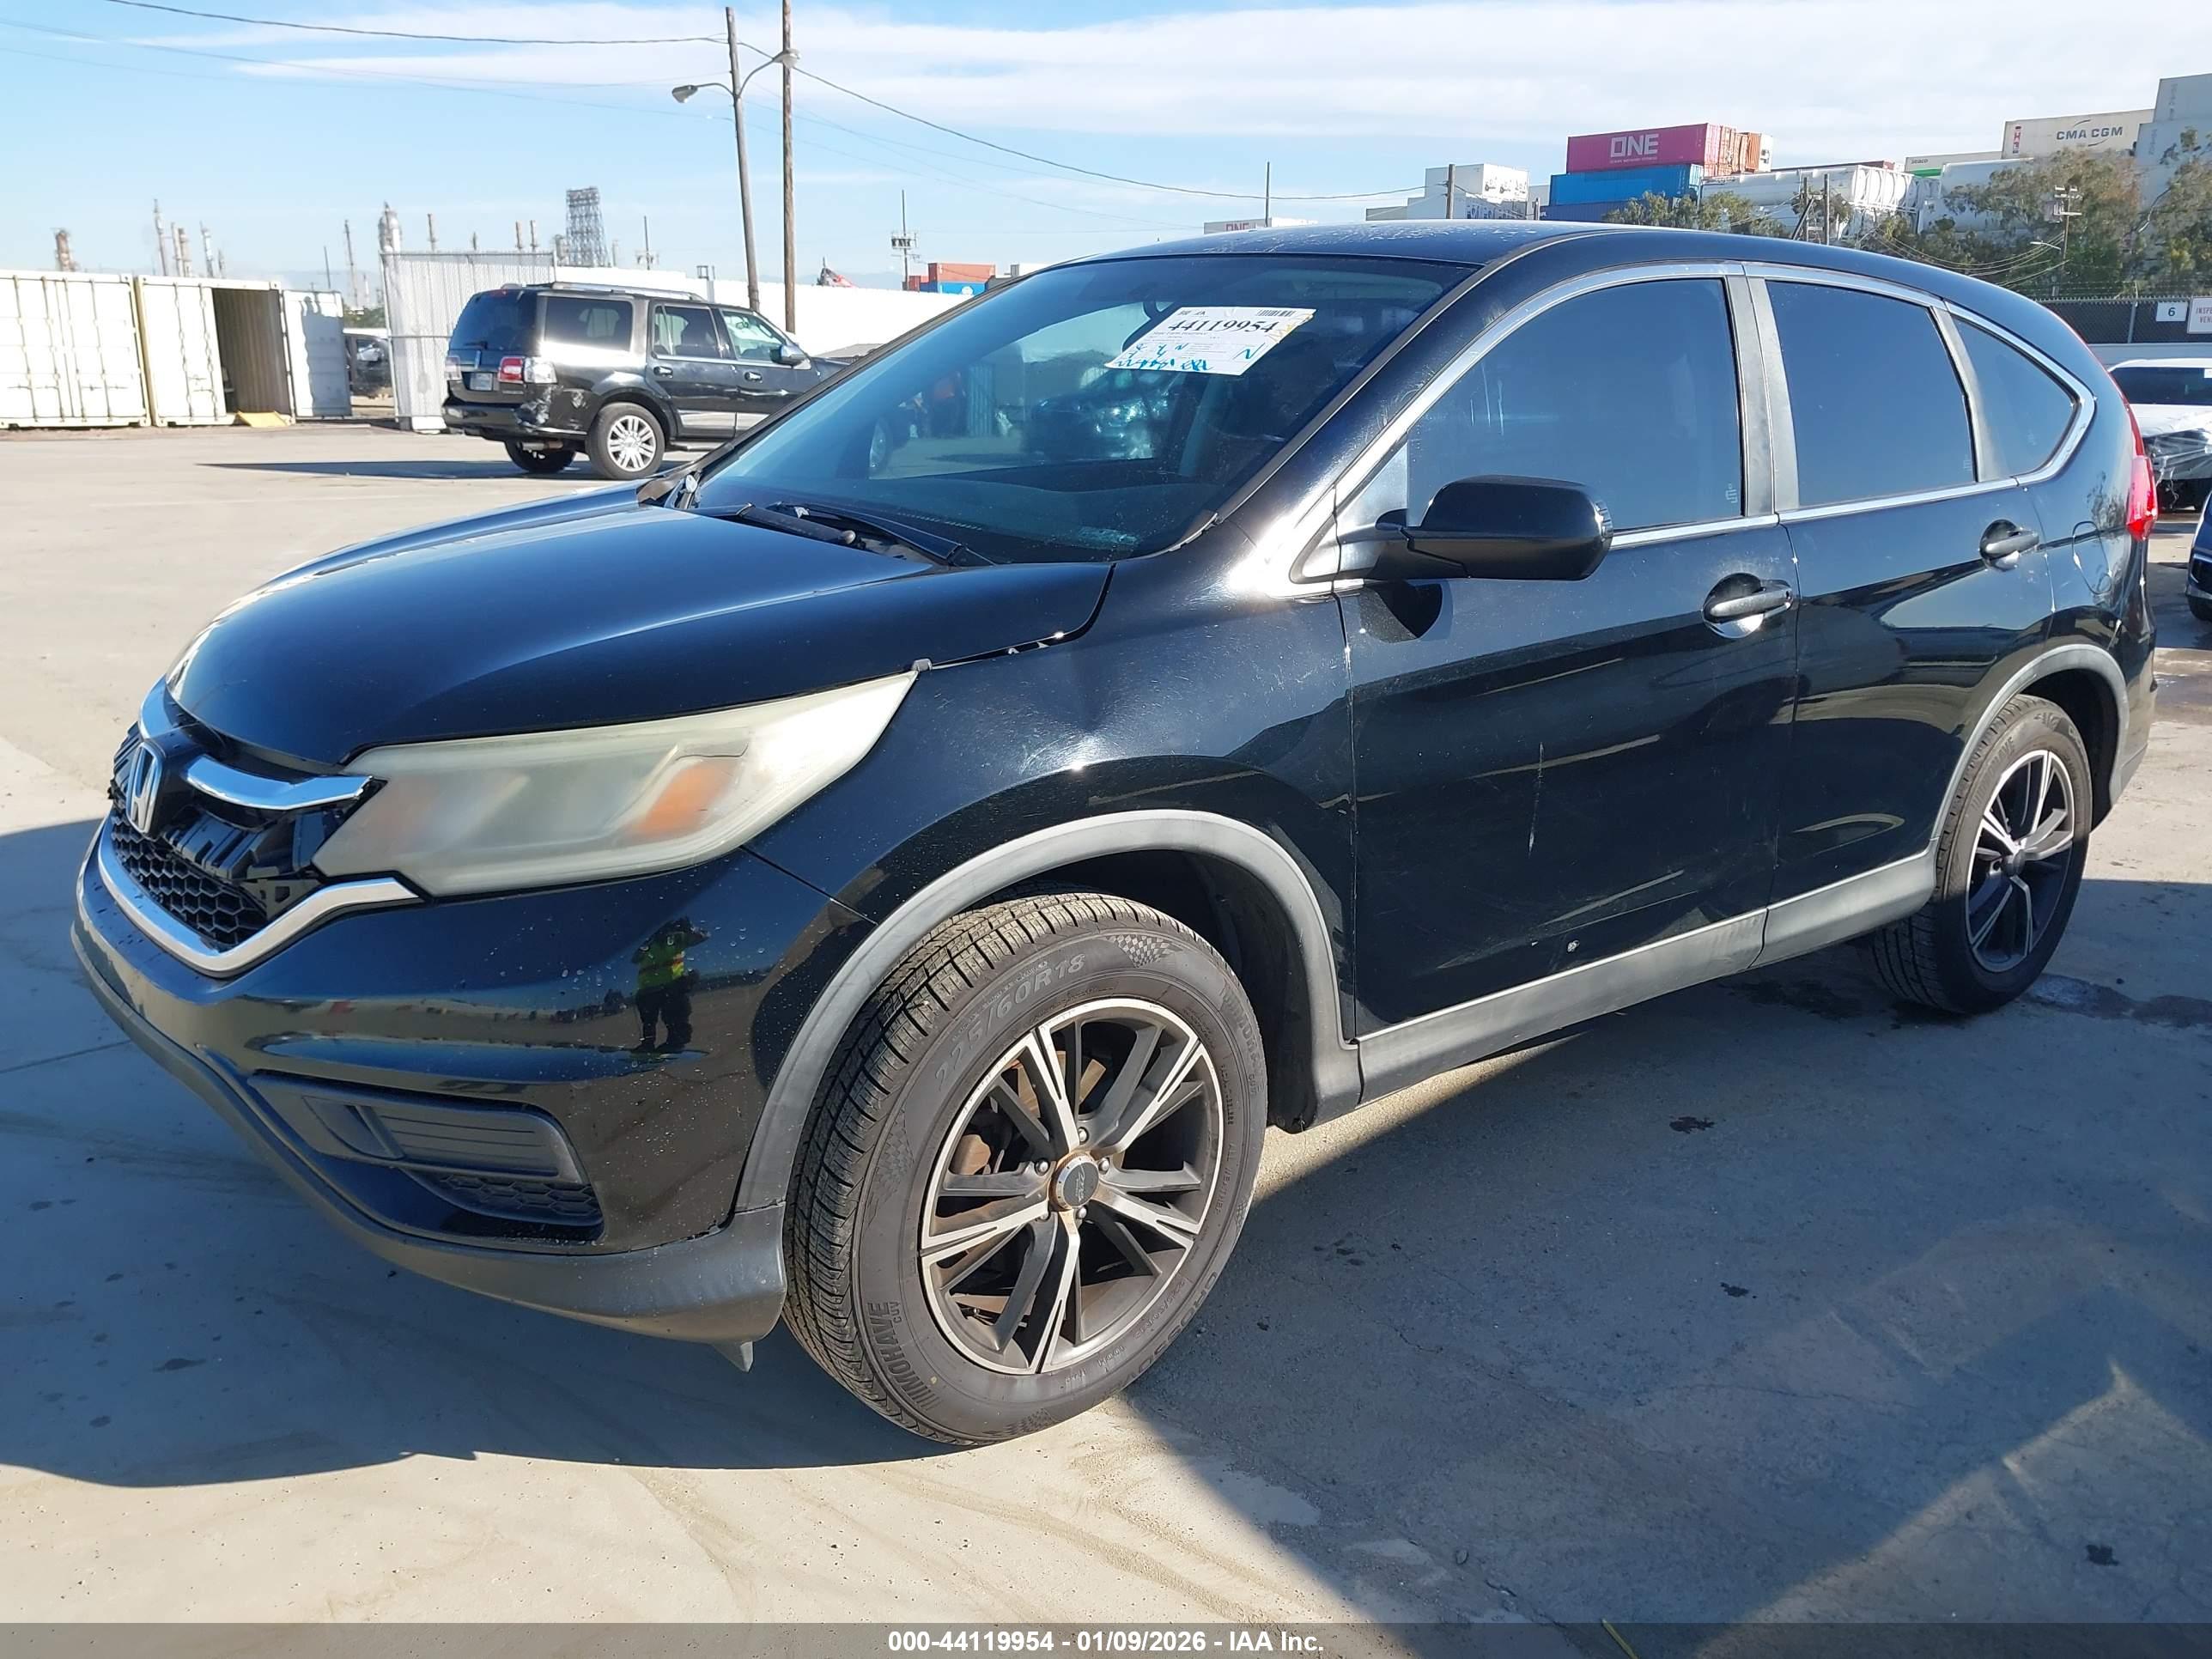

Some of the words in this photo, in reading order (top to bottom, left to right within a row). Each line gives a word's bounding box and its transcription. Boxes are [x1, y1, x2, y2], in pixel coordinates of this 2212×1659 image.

[2056, 129, 2086, 140] CMA
[2091, 126, 2123, 137] CGM
[1610, 133, 1659, 158] ONE
[2168, 307, 2176, 316] 6
[1168, 319, 1279, 332] 44119954
[933, 952, 1086, 1091] 225/60R18
[890, 1302, 902, 1323] CUV
[867, 1302, 927, 1393] MOHAVE
